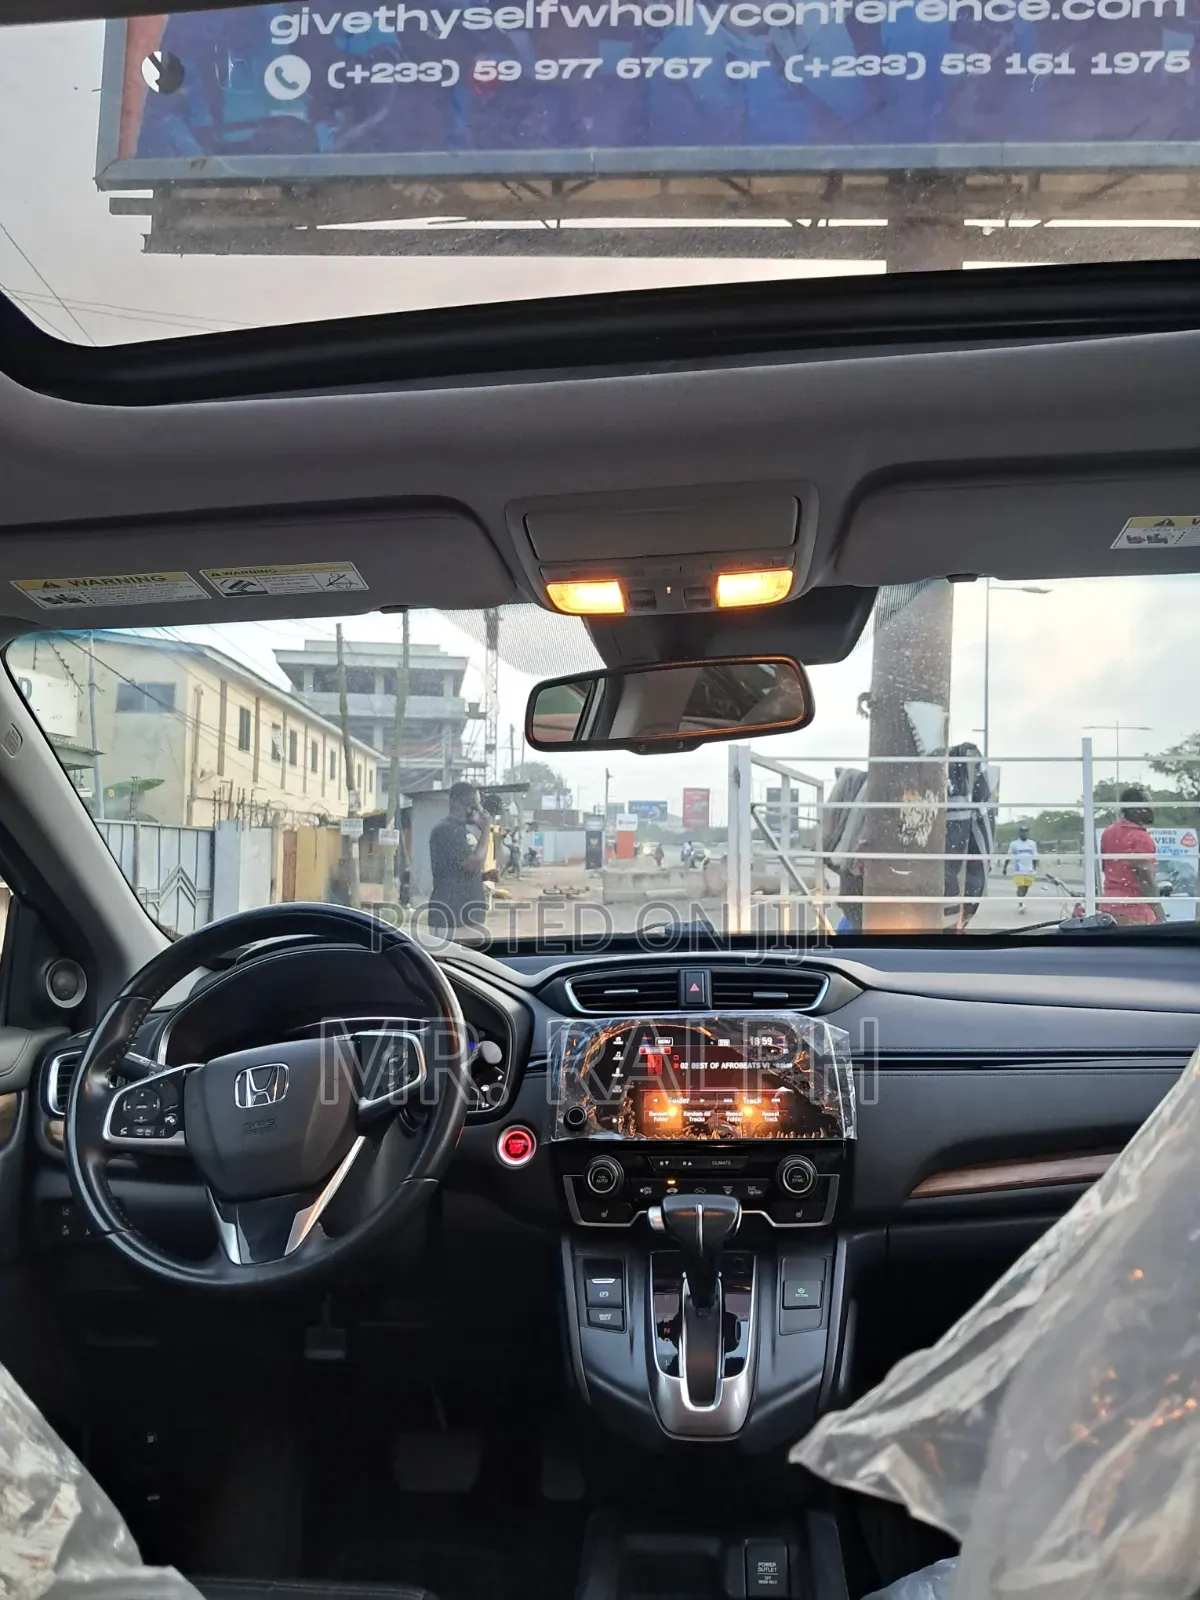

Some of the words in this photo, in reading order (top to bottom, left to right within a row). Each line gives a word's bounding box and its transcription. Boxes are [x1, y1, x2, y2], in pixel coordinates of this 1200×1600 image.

[269, 0, 1185, 45] givethyselfwhollyconference.com
[328, 59, 460, 89] (+233)
[472, 60, 522, 81] 59
[534, 58, 604, 80] 977
[616, 56, 713, 79] 6767
[725, 60, 771, 79] or
[784, 52, 926, 83] (+233)
[940, 53, 992, 75] 53
[1005, 53, 1076, 75] 161
[1090, 51, 1191, 74] 1975
[220, 569, 278, 580] WARNING
[67, 574, 167, 588] WARNING
[721, 1061, 760, 1069] AFROBEATS
[668, 1096, 690, 1104] Folder
[743, 1096, 762, 1104] Track
